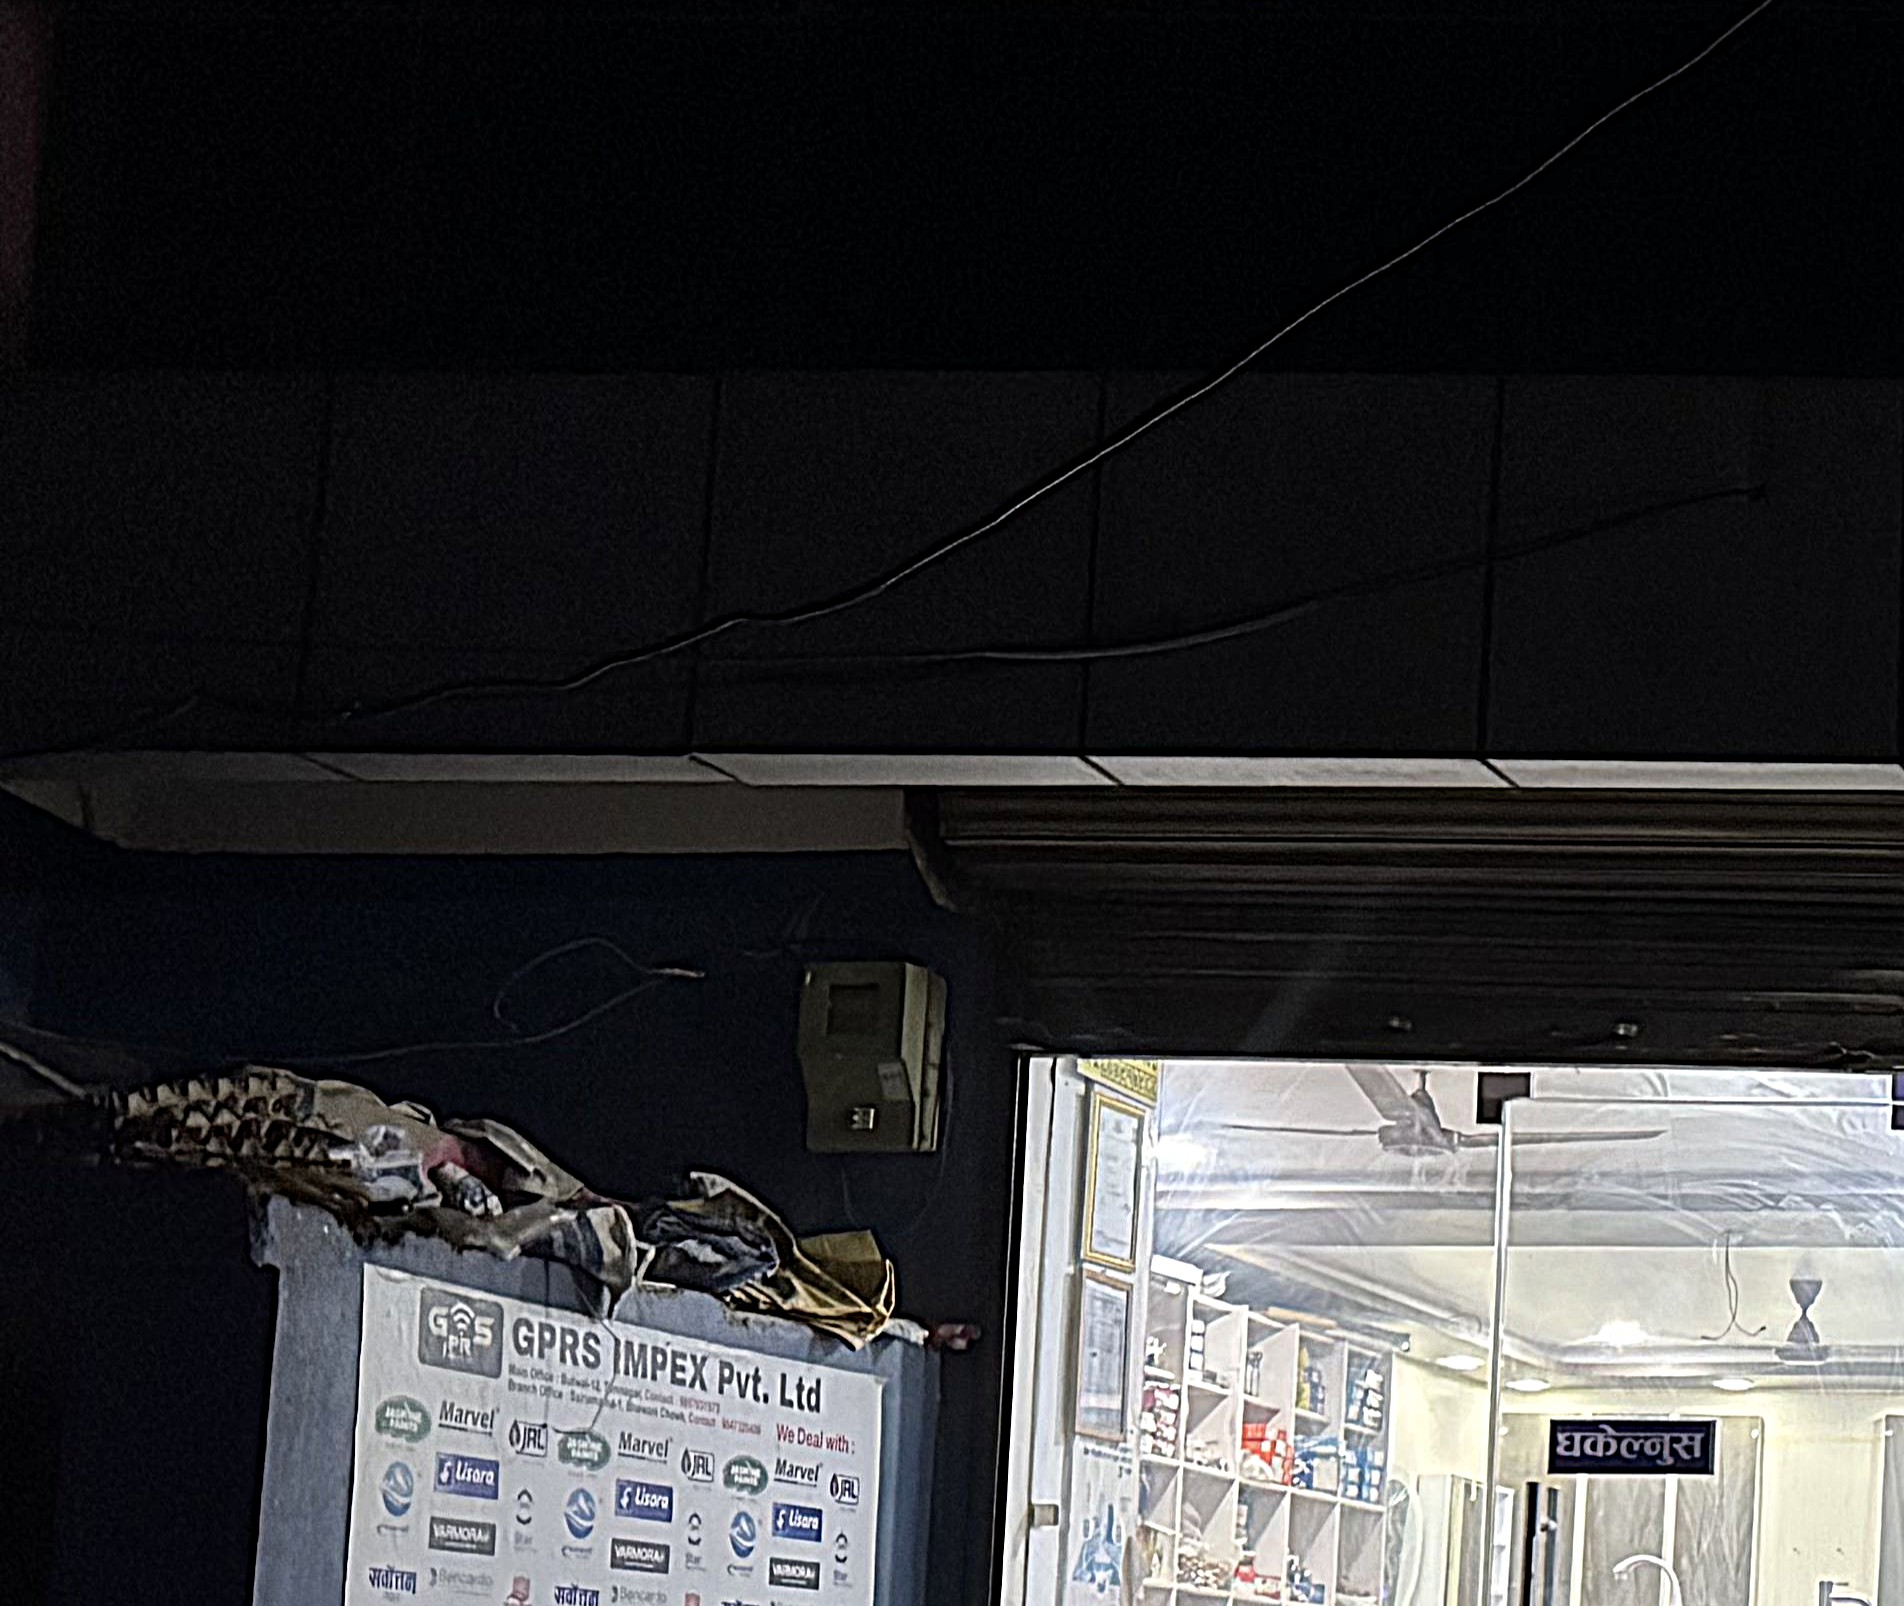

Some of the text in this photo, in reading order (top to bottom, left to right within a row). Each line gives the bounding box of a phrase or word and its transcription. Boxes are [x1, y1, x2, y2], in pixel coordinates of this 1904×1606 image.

[512, 1317, 822, 1414] GPRS IMPEX Pvt. Ltd
[439, 1400, 496, 1429] Marvel
[618, 1431, 669, 1458] Marvel
[776, 1423, 795, 1445] We
[797, 1428, 823, 1448] Deal
[825, 1435, 850, 1454] with
[455, 1460, 495, 1486] Lisora
[774, 1458, 819, 1482] Marvel
[635, 1486, 669, 1509] Lisora
